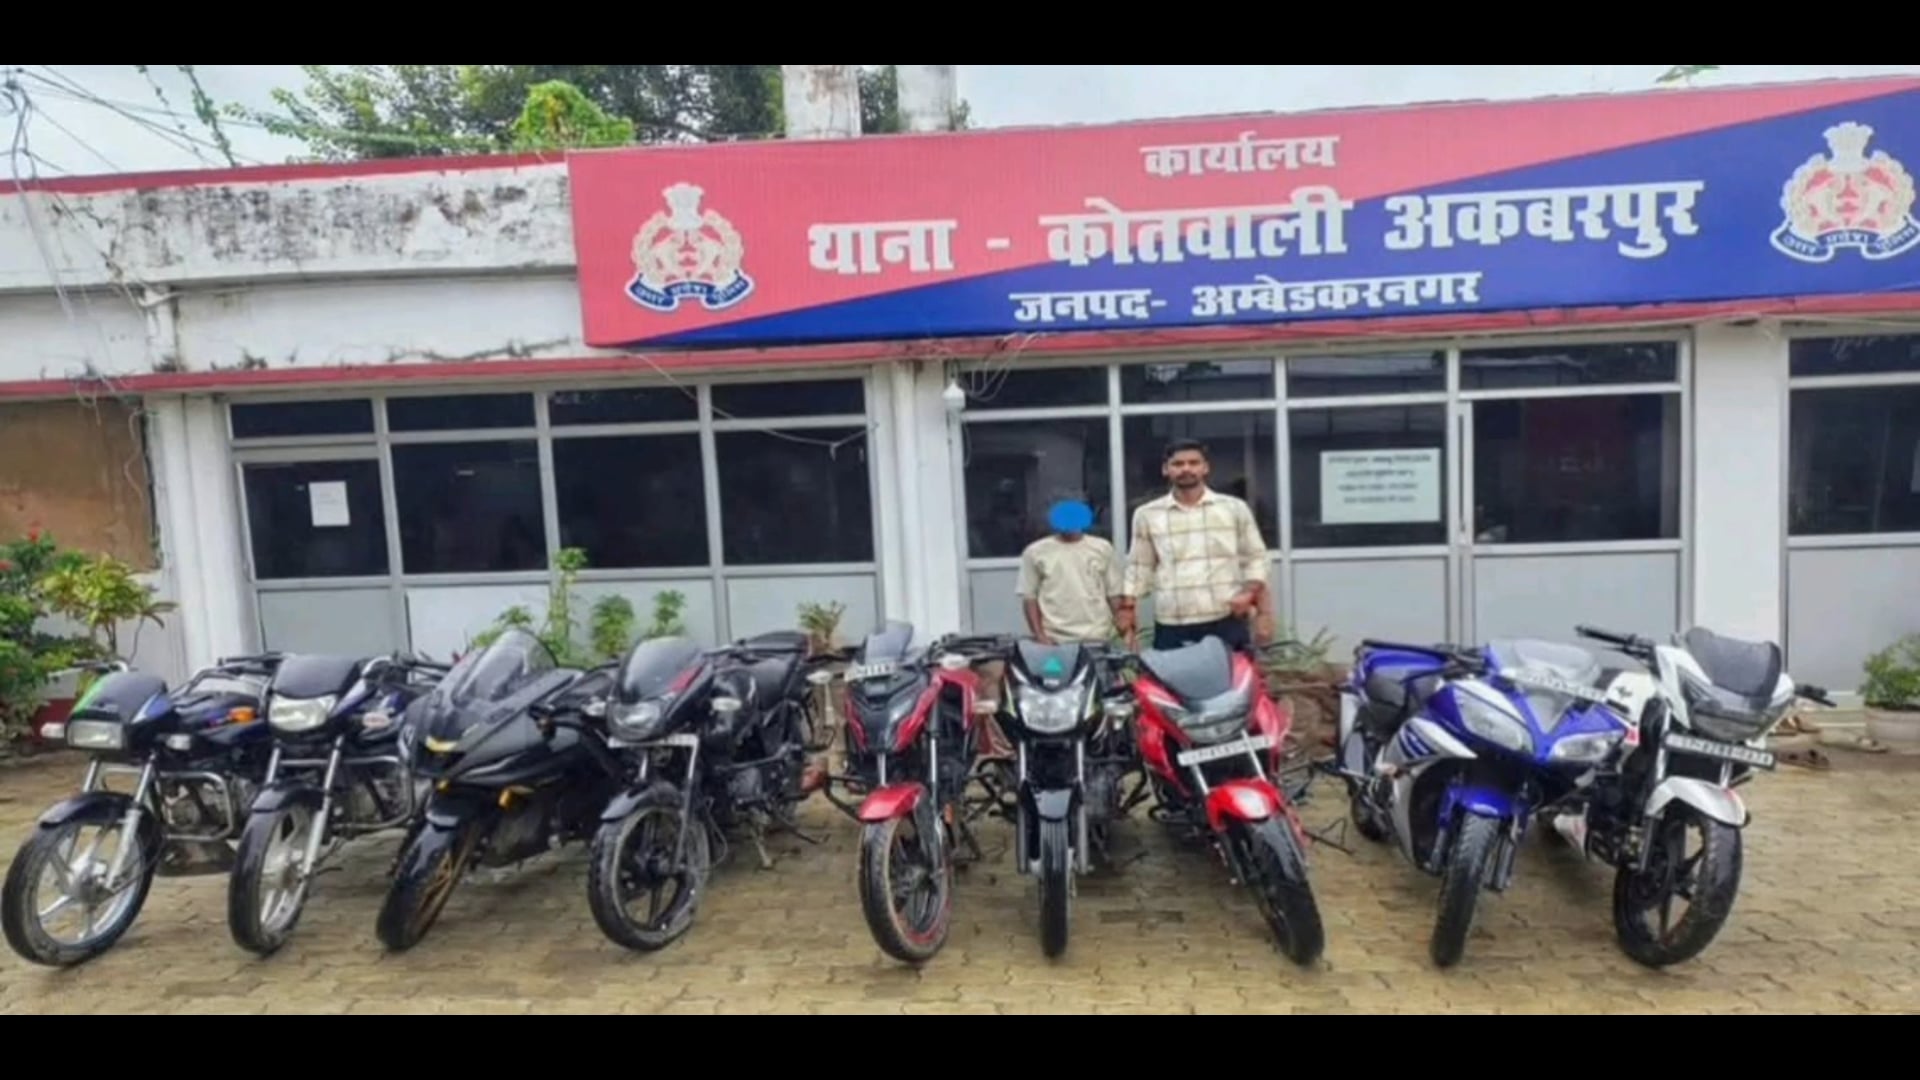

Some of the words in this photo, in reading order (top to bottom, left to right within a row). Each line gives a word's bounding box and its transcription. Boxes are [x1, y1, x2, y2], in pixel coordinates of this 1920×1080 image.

[1140, 131, 1339, 177] कार्यालय
[808, 219, 957, 275] थाना
[1038, 185, 1353, 266] कोतवाली
[1384, 180, 1705, 259] अकबरपुर
[1009, 288, 1166, 322] जनपद-
[1191, 274, 1482, 317] अम्बेडकरनगर
